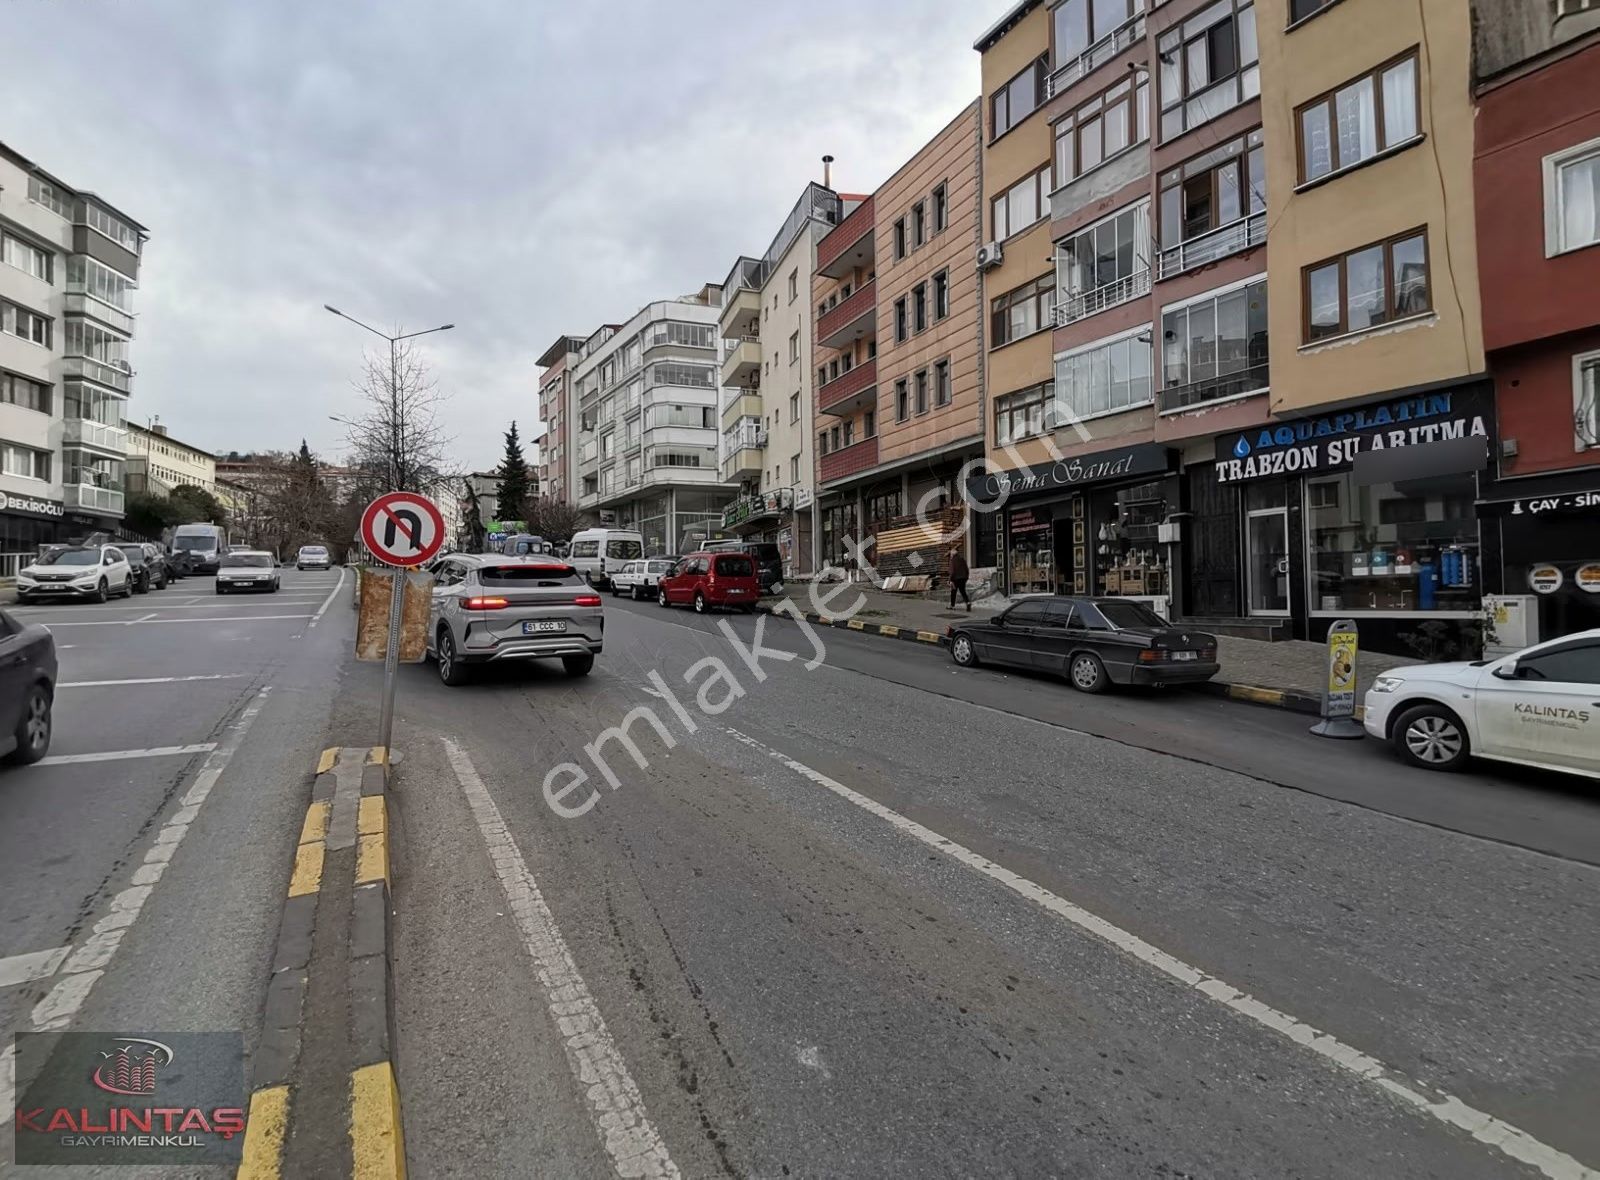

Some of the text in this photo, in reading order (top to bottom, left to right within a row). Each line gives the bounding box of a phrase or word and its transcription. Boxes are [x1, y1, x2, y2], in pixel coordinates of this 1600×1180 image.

[1256, 392, 1451, 448] AQUAPLATIN
[1216, 416, 1489, 482] TRABZON SU ARITMA
[986, 473, 1048, 496] Sema
[8, 497, 64, 516] BEKİROĞLU
[1529, 499, 1559, 514] ÇAY
[528, 623, 536, 631] 61
[540, 622, 554, 630] CCC
[1514, 702, 1590, 724] KALINTAŞ
